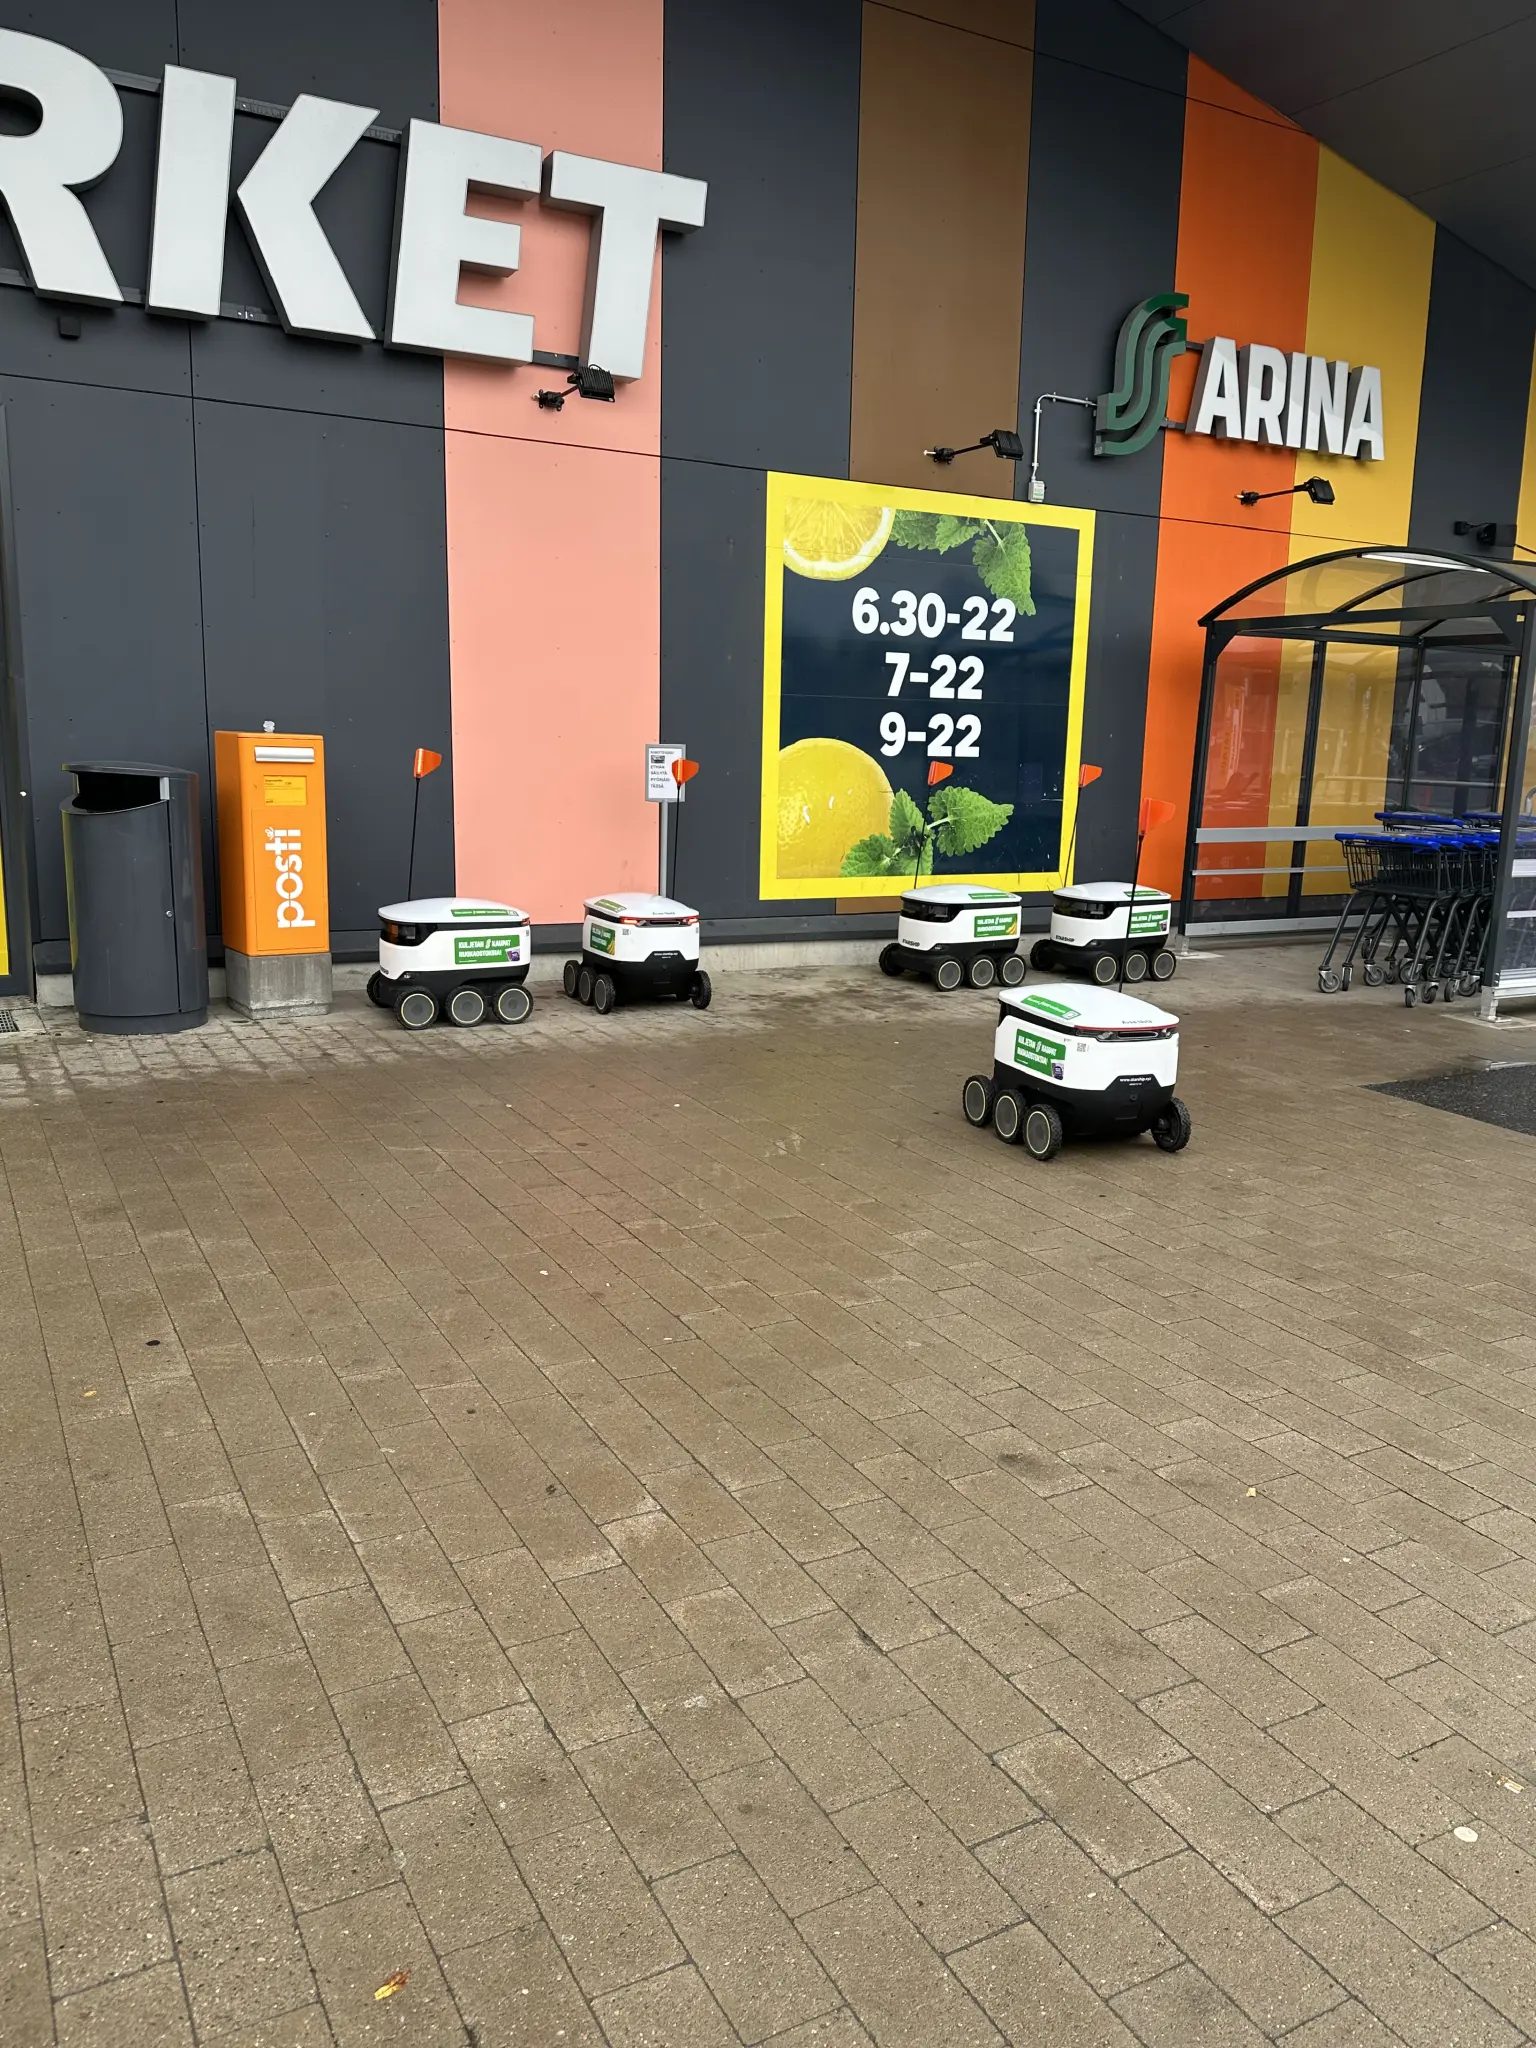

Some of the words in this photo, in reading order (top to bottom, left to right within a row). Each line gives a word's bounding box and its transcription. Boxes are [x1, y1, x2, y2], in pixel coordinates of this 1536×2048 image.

[1191, 336, 1385, 461] ARINA
[852, 586, 1016, 643] 6.30-22
[885, 651, 985, 700] 7-22
[879, 711, 982, 758] 9-22
[265, 827, 316, 928] posti
